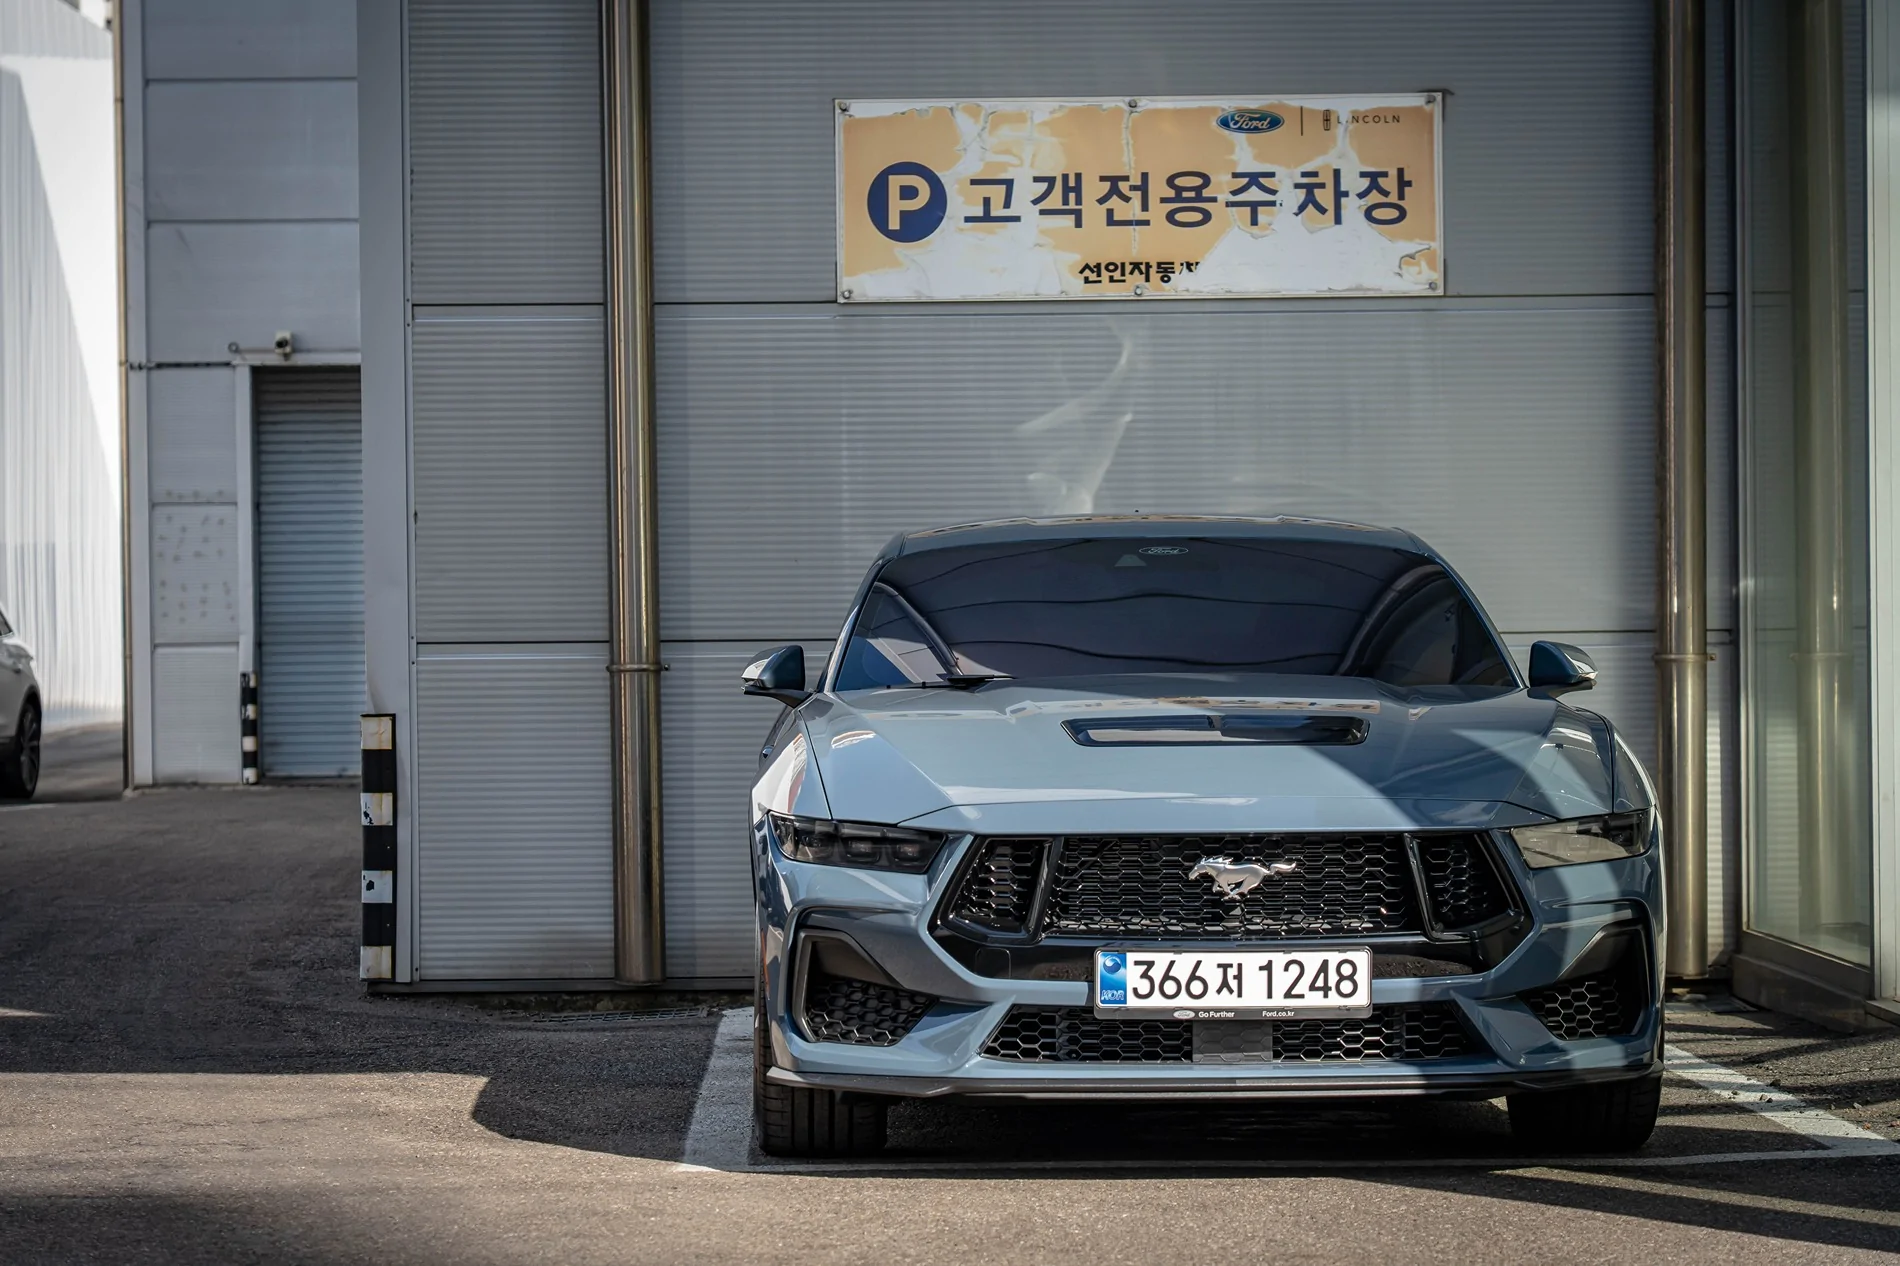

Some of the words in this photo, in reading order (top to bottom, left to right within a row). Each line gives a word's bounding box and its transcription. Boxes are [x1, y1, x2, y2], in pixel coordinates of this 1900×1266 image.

[1229, 112, 1271, 129] Ford
[1336, 114, 1401, 125] LNCOLN
[887, 174, 931, 231] P
[963, 167, 1413, 229] 고객전용주차장
[1132, 960, 1243, 999] 366저
[1258, 958, 1359, 999] 1248
[1101, 989, 1125, 1001] KOR
[1209, 1010, 1235, 1018] Further
